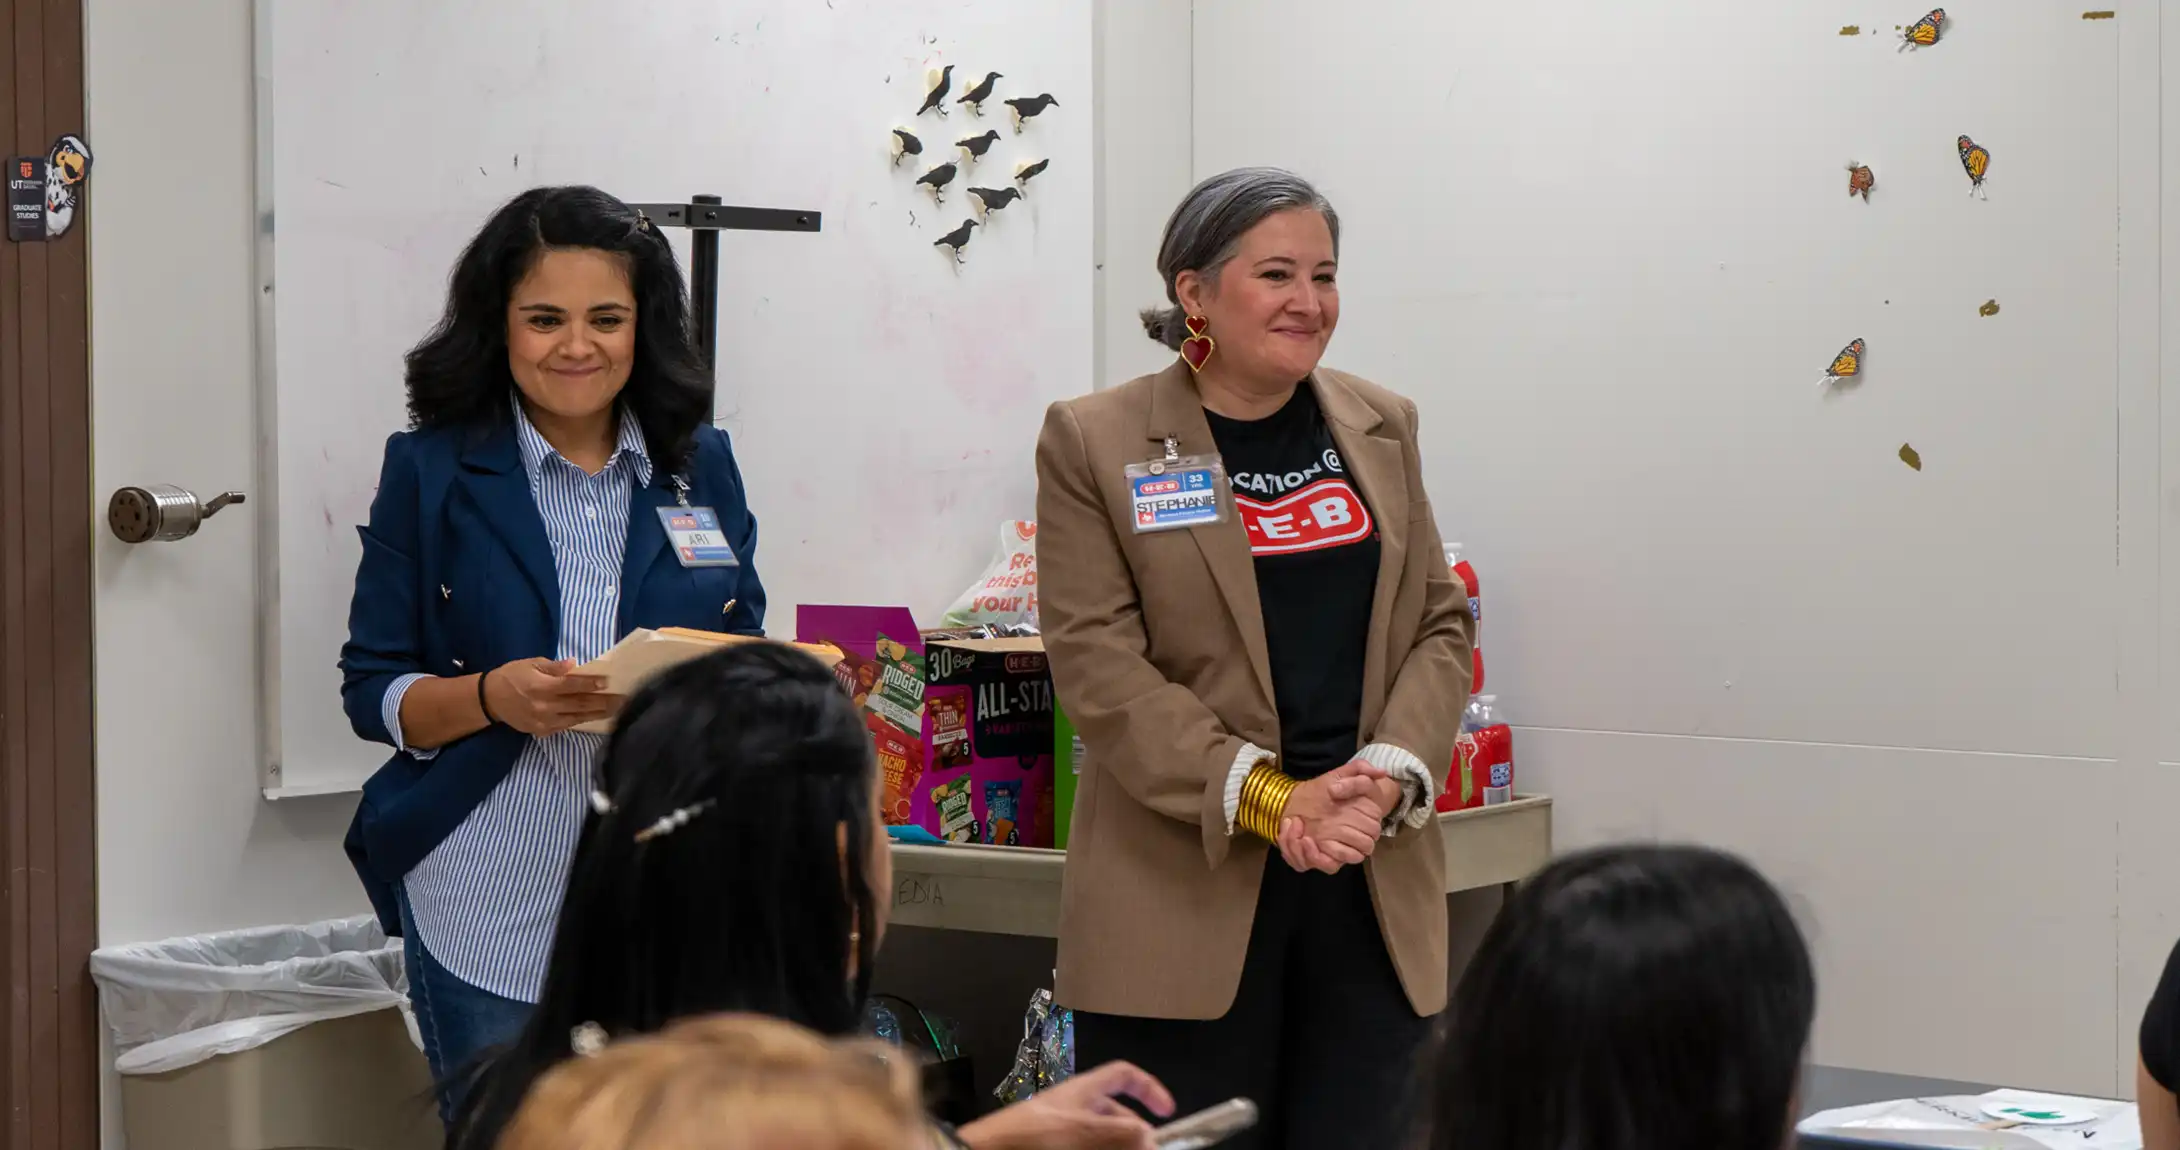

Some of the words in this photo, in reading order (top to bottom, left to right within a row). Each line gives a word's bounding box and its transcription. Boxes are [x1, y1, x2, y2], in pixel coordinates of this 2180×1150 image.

[11, 180, 23, 189] UT
[1189, 474, 1203, 483] 33
[1136, 495, 1216, 513] STEPHANIE
[689, 533, 710, 545] ARI
[969, 596, 1024, 613] your
[929, 648, 952, 682] 30
[953, 653, 976, 669] Bags
[882, 664, 925, 700] RIDGED
[939, 708, 959, 727] THIN
[963, 742, 970, 756] 5
[972, 821, 979, 835] 5
[1009, 831, 1018, 845] 5
